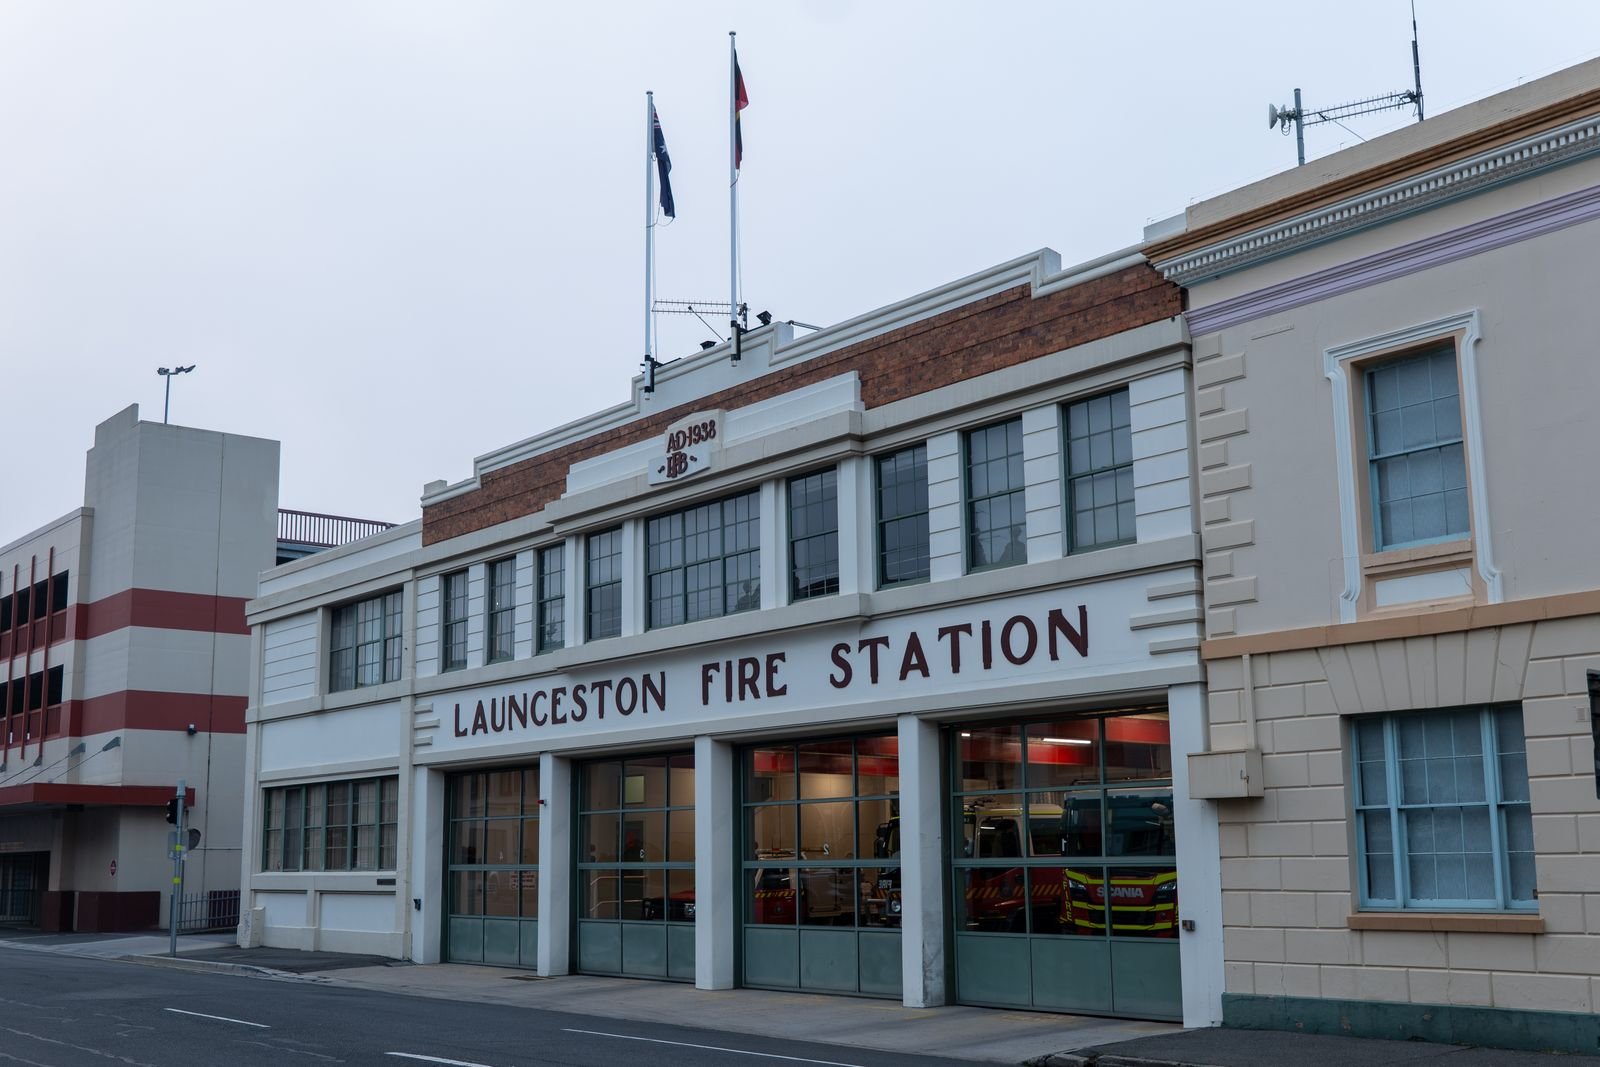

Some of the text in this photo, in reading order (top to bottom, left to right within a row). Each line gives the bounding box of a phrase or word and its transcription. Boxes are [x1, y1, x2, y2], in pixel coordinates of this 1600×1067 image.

[454, 604, 1088, 737] LAUNCESTON FIRE STATION
